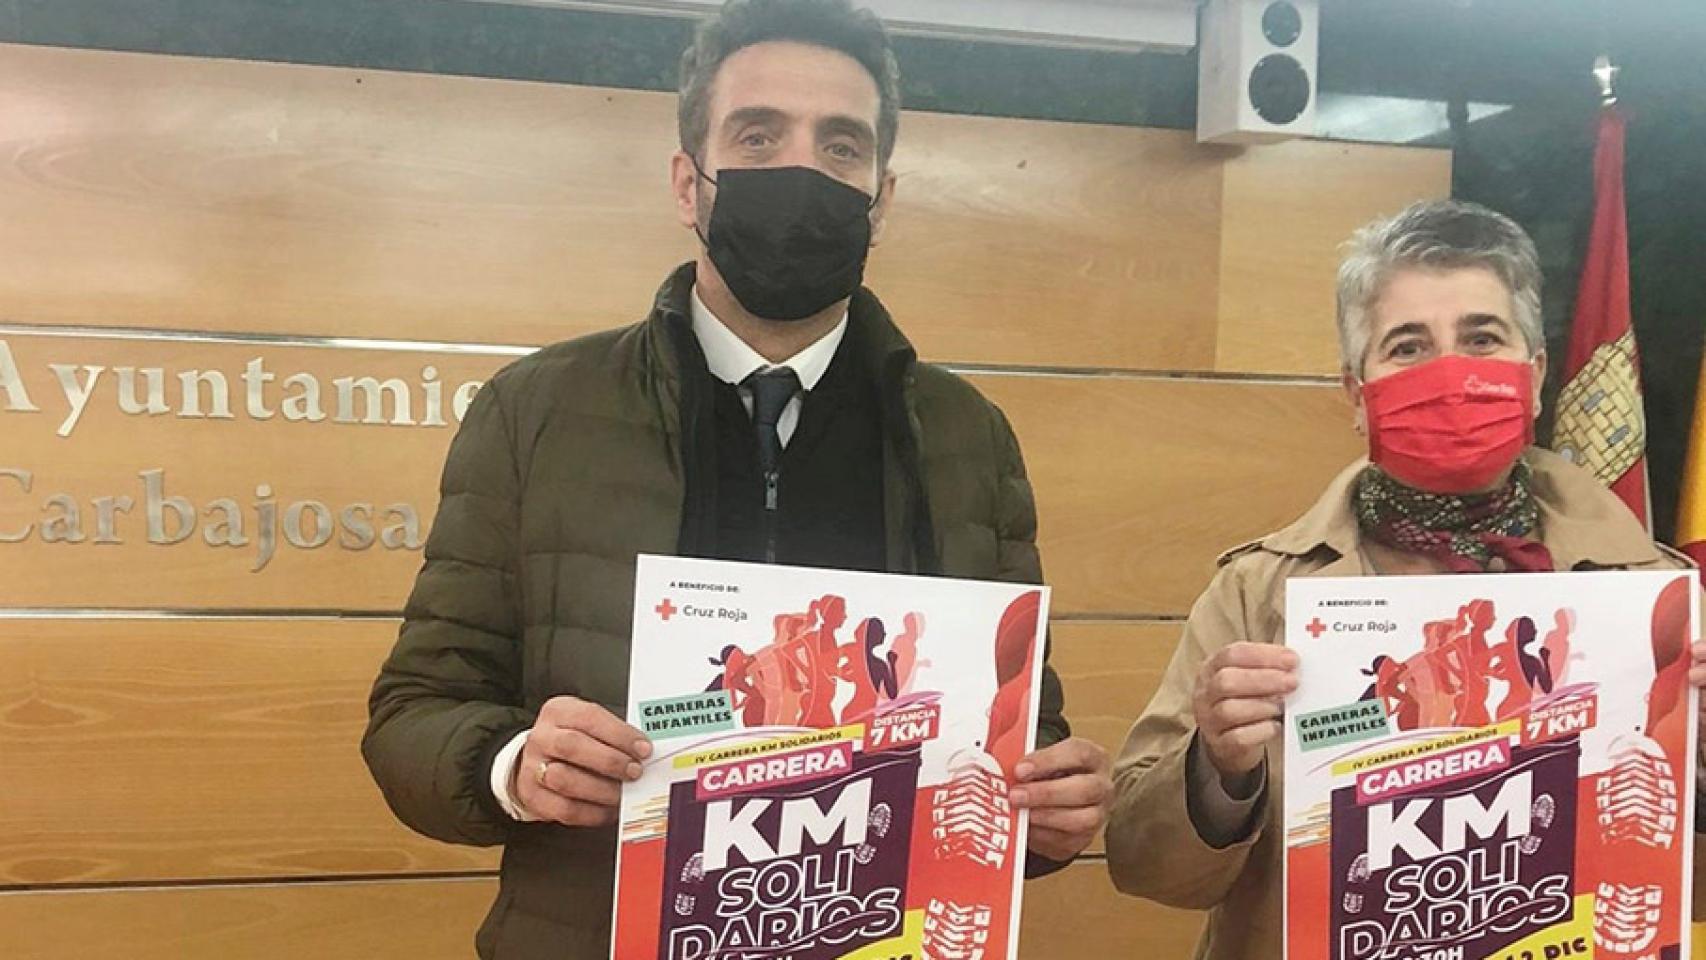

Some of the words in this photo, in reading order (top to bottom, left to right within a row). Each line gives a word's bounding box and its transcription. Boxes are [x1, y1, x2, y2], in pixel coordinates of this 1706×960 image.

[669, 580, 676, 588] A
[678, 581, 725, 593] BENEFICIO
[683, 604, 714, 617] Cruz
[717, 607, 748, 623] Roja
[1332, 621, 1363, 632] Cruz
[1367, 620, 1398, 634] Roja
[643, 696, 725, 717] CARRERAS
[645, 710, 732, 732] INFANTILES
[874, 709, 937, 726] DISTANCIA
[1299, 703, 1380, 729] CARRERAS
[870, 728, 885, 746] 7
[890, 719, 930, 743] KM
[1302, 717, 1387, 742] INFANTILES
[1526, 720, 1543, 741] 7
[1547, 709, 1588, 736] KM
[694, 755, 707, 764] IV
[708, 746, 759, 762] CARRERA
[761, 742, 778, 753] KM
[780, 730, 842, 750] SOLIDARIOS
[1366, 748, 1414, 766] CARRERA
[1417, 743, 1434, 753] KM
[1435, 727, 1498, 750] SOLIDARIOS
[702, 748, 848, 791] CARRERA
[1361, 745, 1505, 796] CARRERA
[702, 778, 872, 871] KM
[1367, 770, 1532, 871] KM
[716, 850, 854, 917] SOLI
[1384, 841, 1520, 913] SOLI
[669, 887, 900, 960] DARIOS
[1340, 875, 1570, 960] DARIOS
[1543, 936, 1588, 959] DIC
